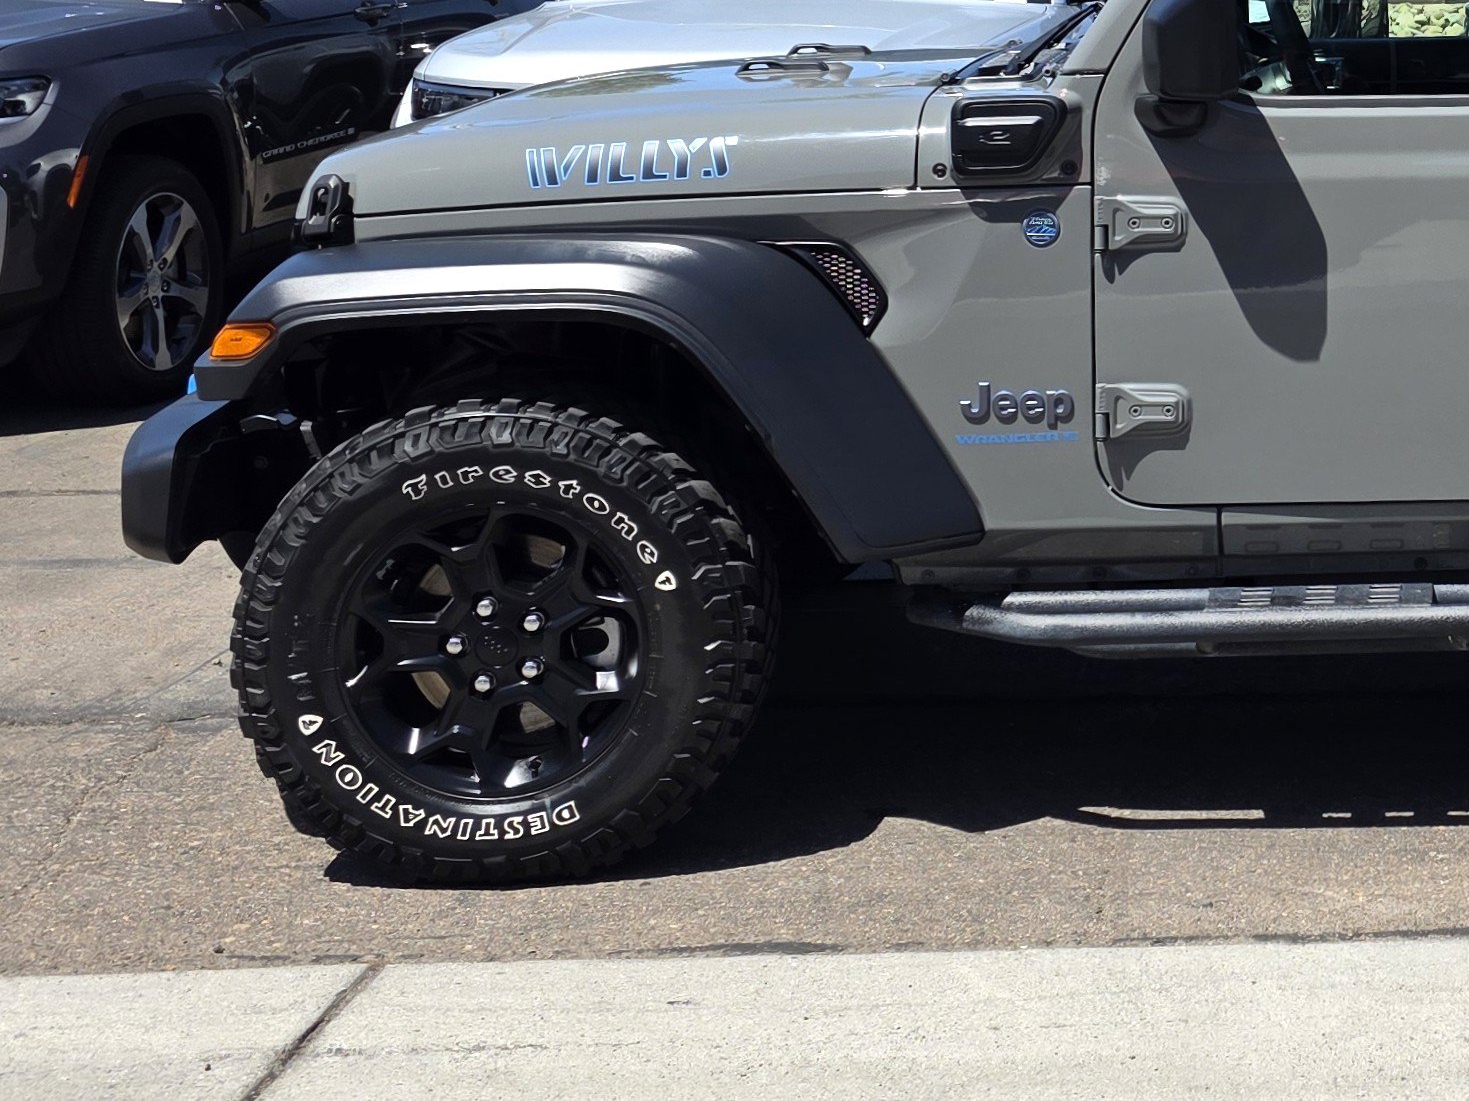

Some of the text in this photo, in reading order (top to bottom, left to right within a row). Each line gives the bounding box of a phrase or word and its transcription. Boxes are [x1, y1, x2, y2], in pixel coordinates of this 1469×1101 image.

[525, 135, 739, 189] WILLYS
[959, 381, 1075, 431] Jeep
[955, 431, 1059, 445] WRANGLER
[402, 465, 658, 565] Firestone
[312, 739, 581, 841] DESTINATION
